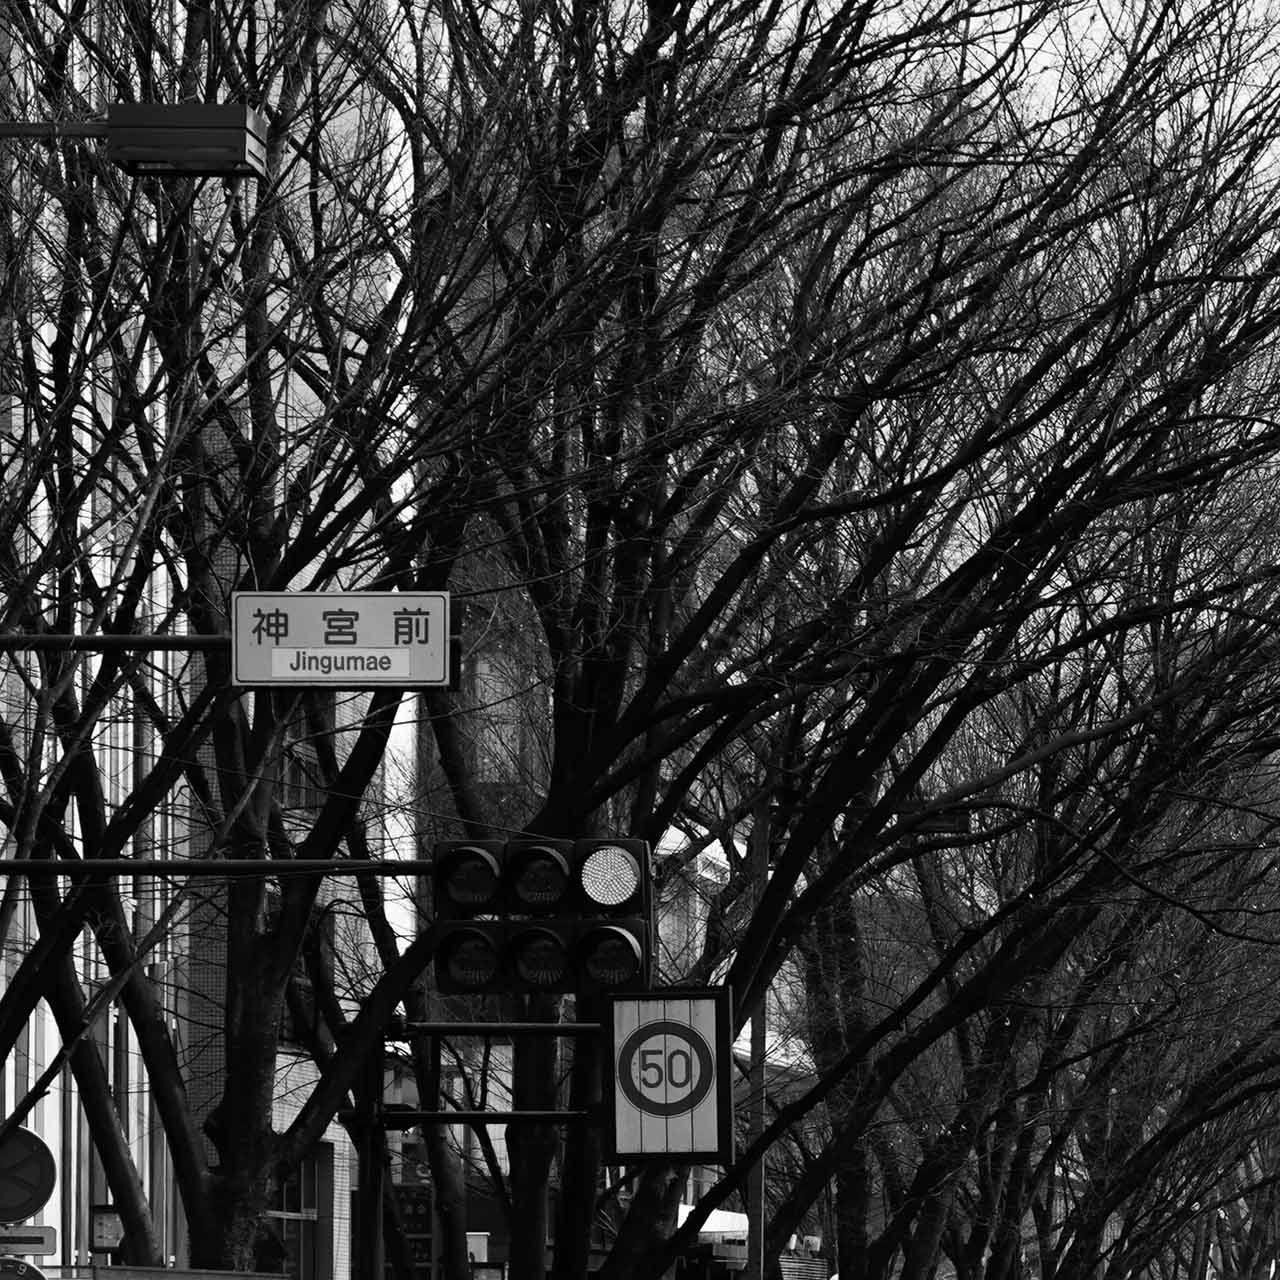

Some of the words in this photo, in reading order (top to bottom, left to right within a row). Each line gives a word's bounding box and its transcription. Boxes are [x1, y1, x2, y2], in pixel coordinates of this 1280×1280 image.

[252, 608, 430, 645] 神宮前
[290, 651, 392, 673] Jingumae
[641, 1050, 690, 1088] 50
